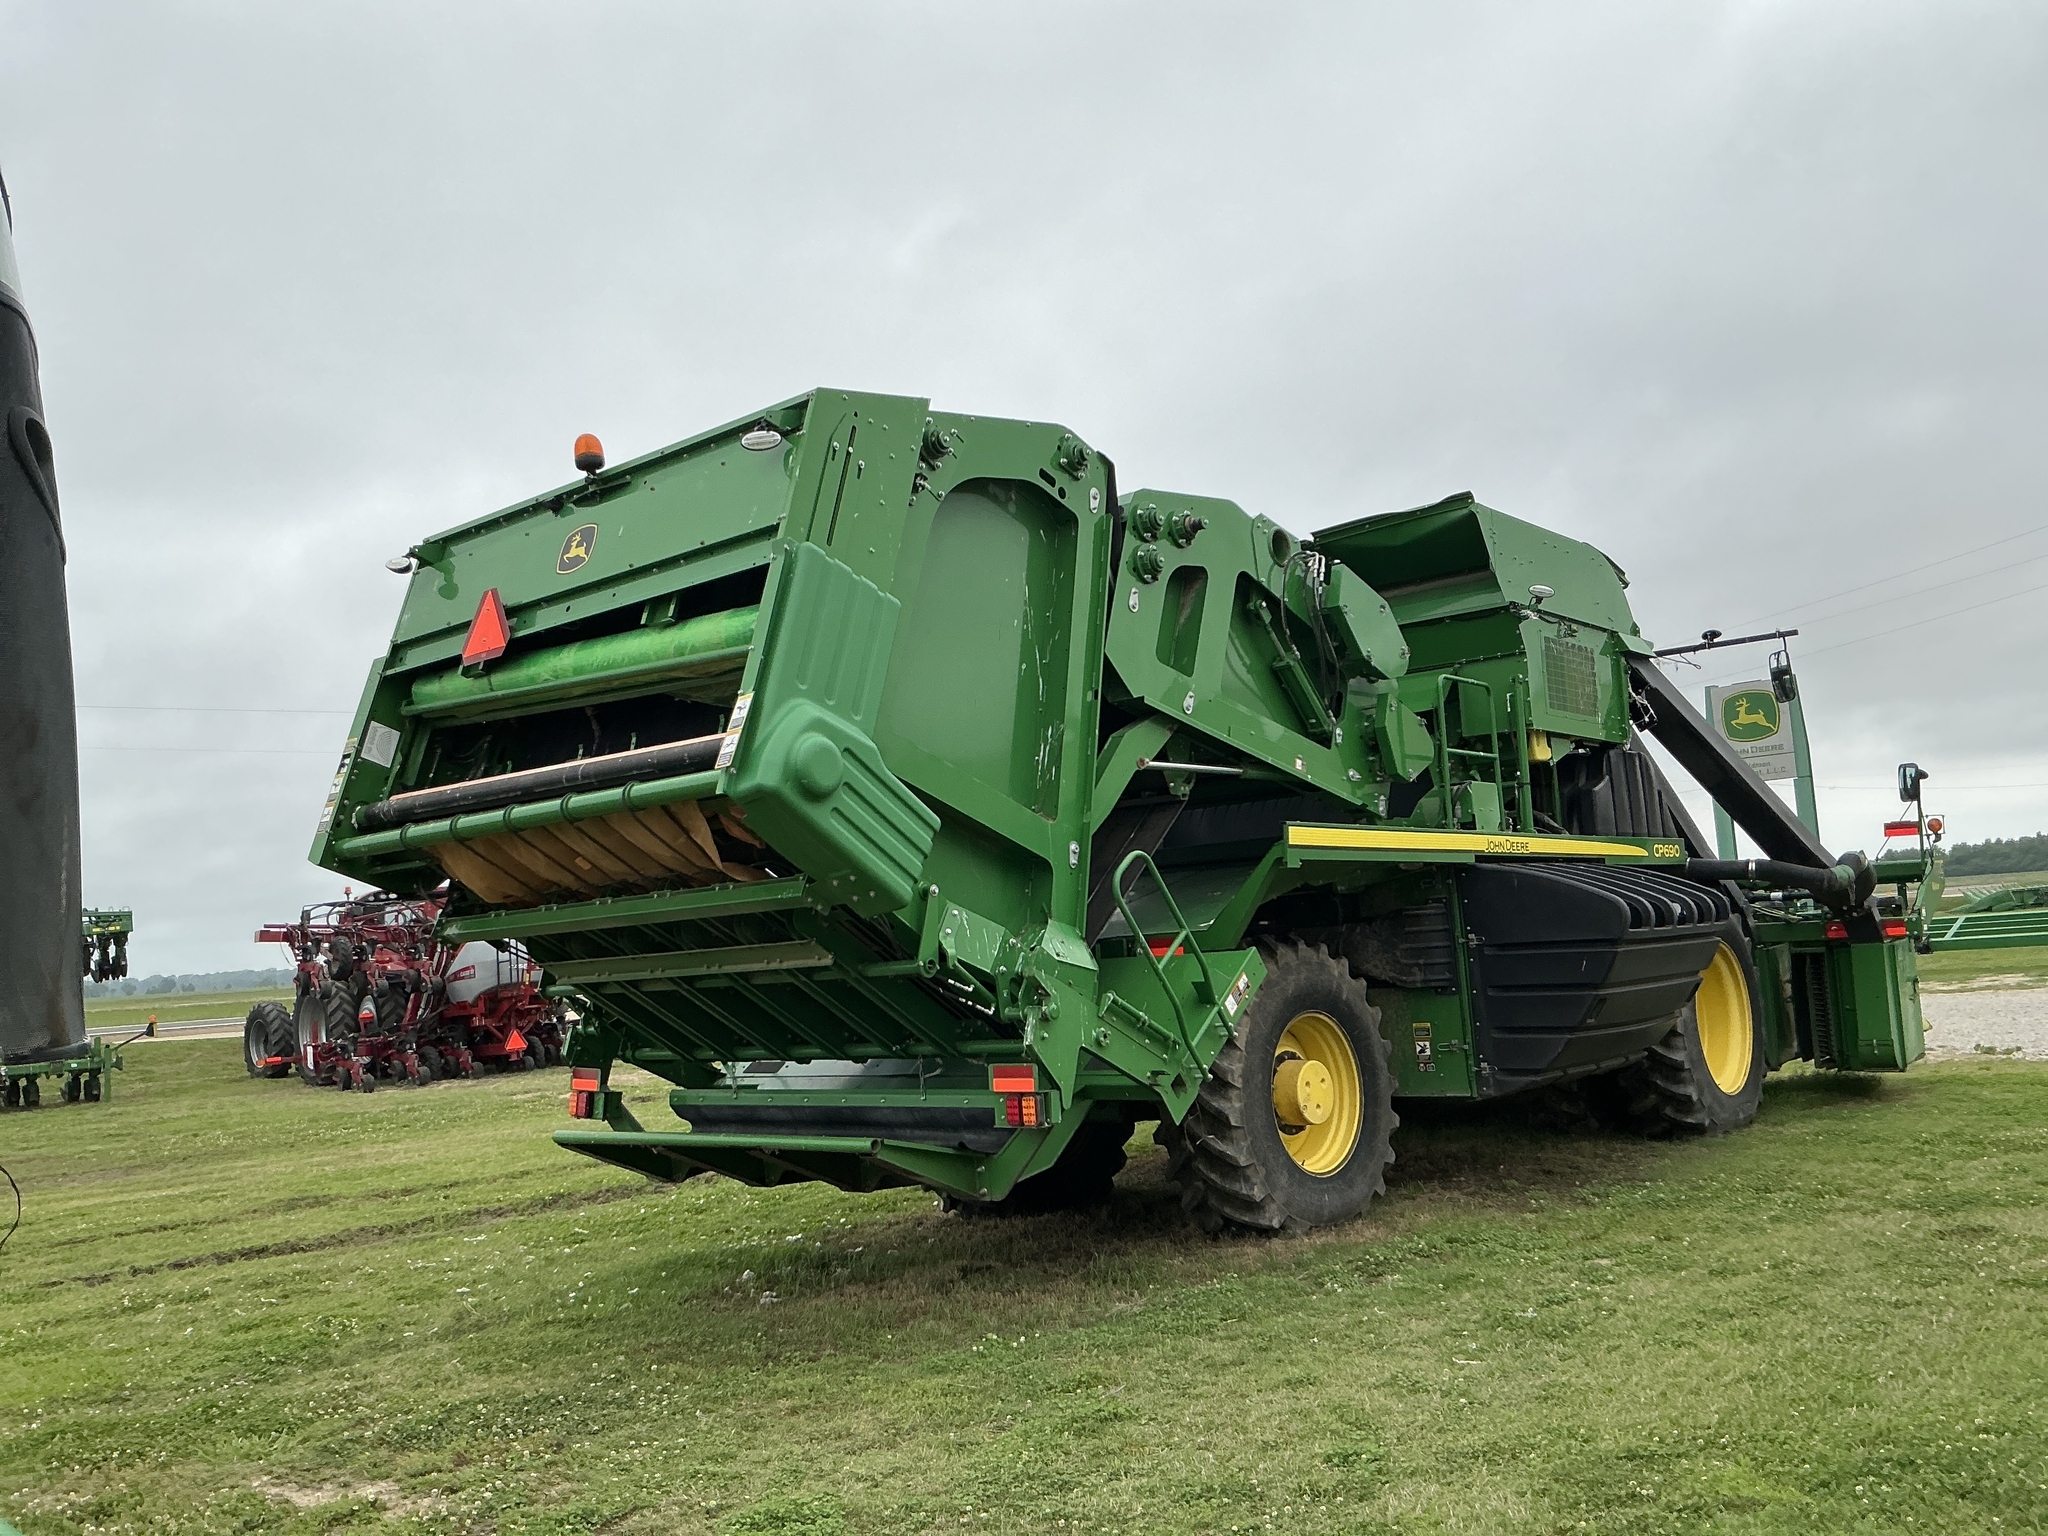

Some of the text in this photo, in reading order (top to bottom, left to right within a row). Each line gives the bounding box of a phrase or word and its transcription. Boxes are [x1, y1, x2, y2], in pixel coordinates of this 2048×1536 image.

[1750, 744, 1784, 753] DEERE
[1485, 838, 1530, 852] JOHN DEERE
[1653, 843, 1680, 858] CP690
